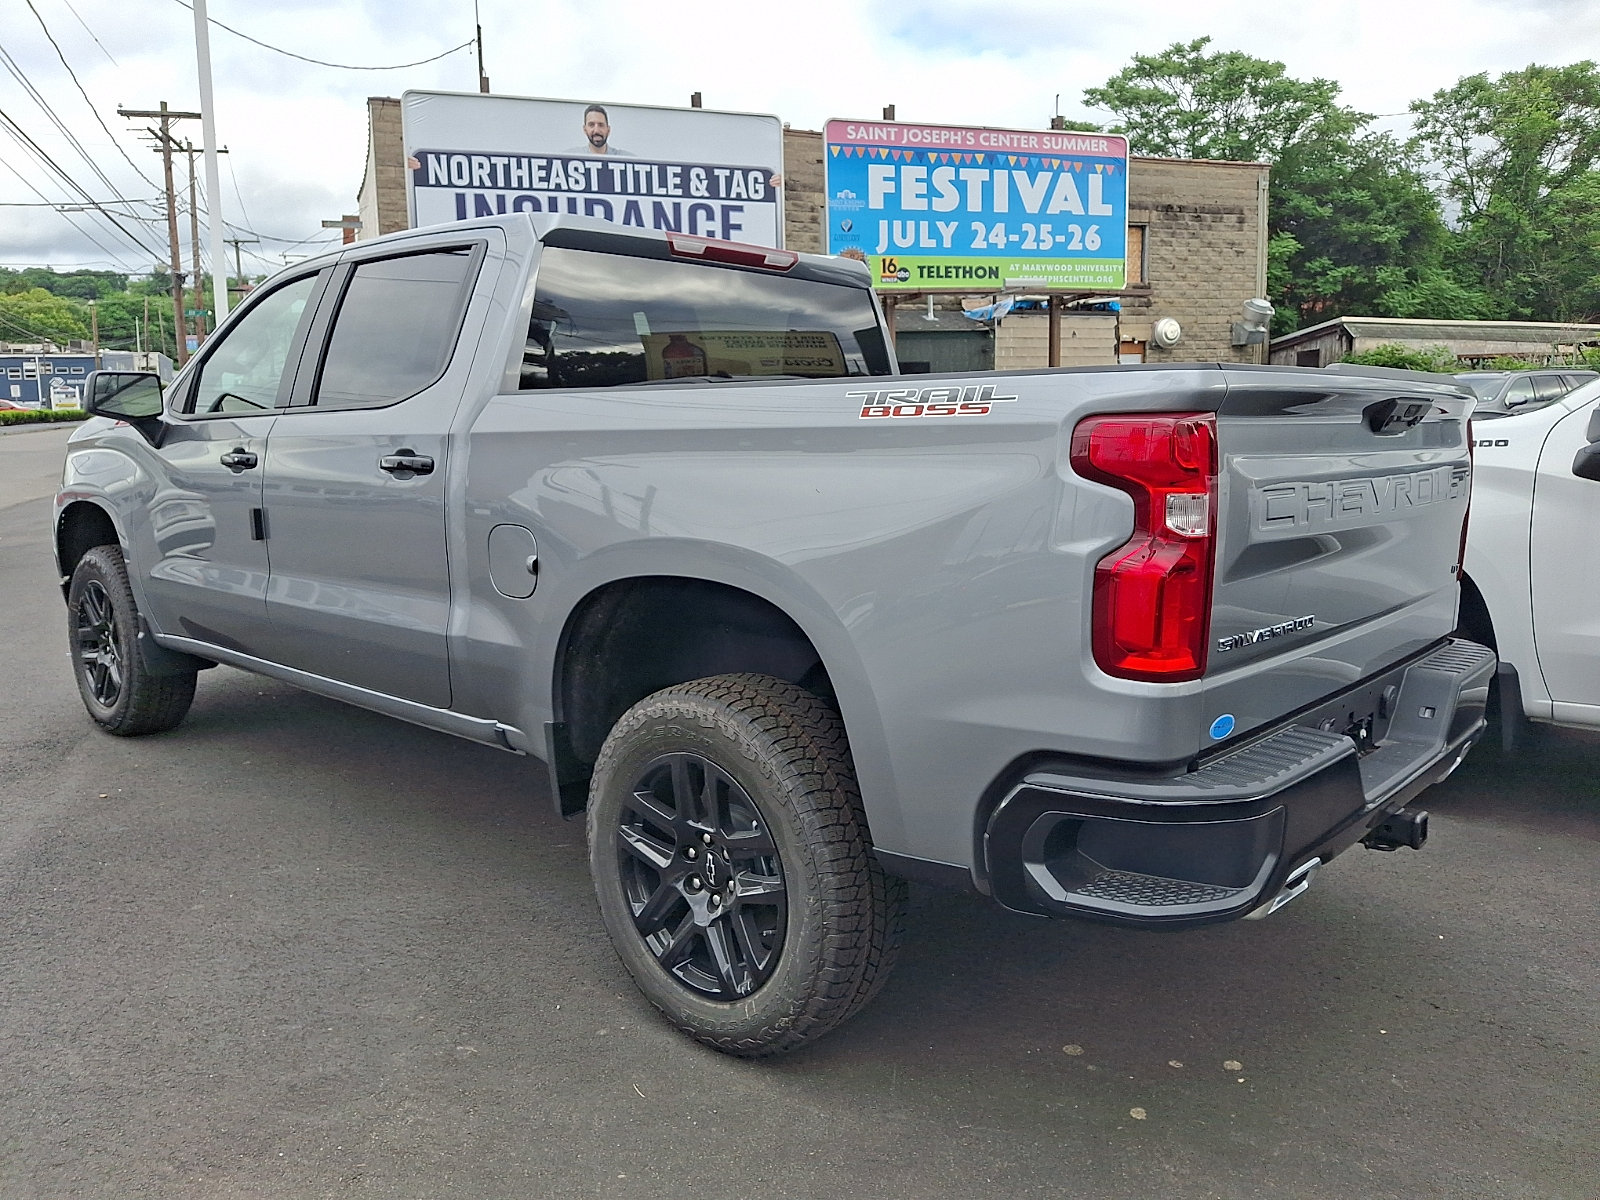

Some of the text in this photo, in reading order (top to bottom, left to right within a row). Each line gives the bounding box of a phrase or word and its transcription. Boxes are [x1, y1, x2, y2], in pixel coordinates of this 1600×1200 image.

[847, 125, 1108, 152] SAINT JOSEPH'S CENTER SUMMER
[426, 153, 765, 200] NORTHEAST TITLE & TAG
[868, 164, 1112, 216] FESTIVAL
[875, 220, 959, 255] JULY
[970, 221, 1101, 251] 24-25-26
[881, 258, 897, 274] 16
[917, 265, 999, 279] TELETHON
[1022, 264, 1072, 272] MARYWOOD
[1075, 264, 1123, 272] UNIVERSITY
[846, 384, 1019, 406] TRAIL
[858, 401, 993, 420] BOSS
[1217, 614, 1315, 652] SILVERADO
